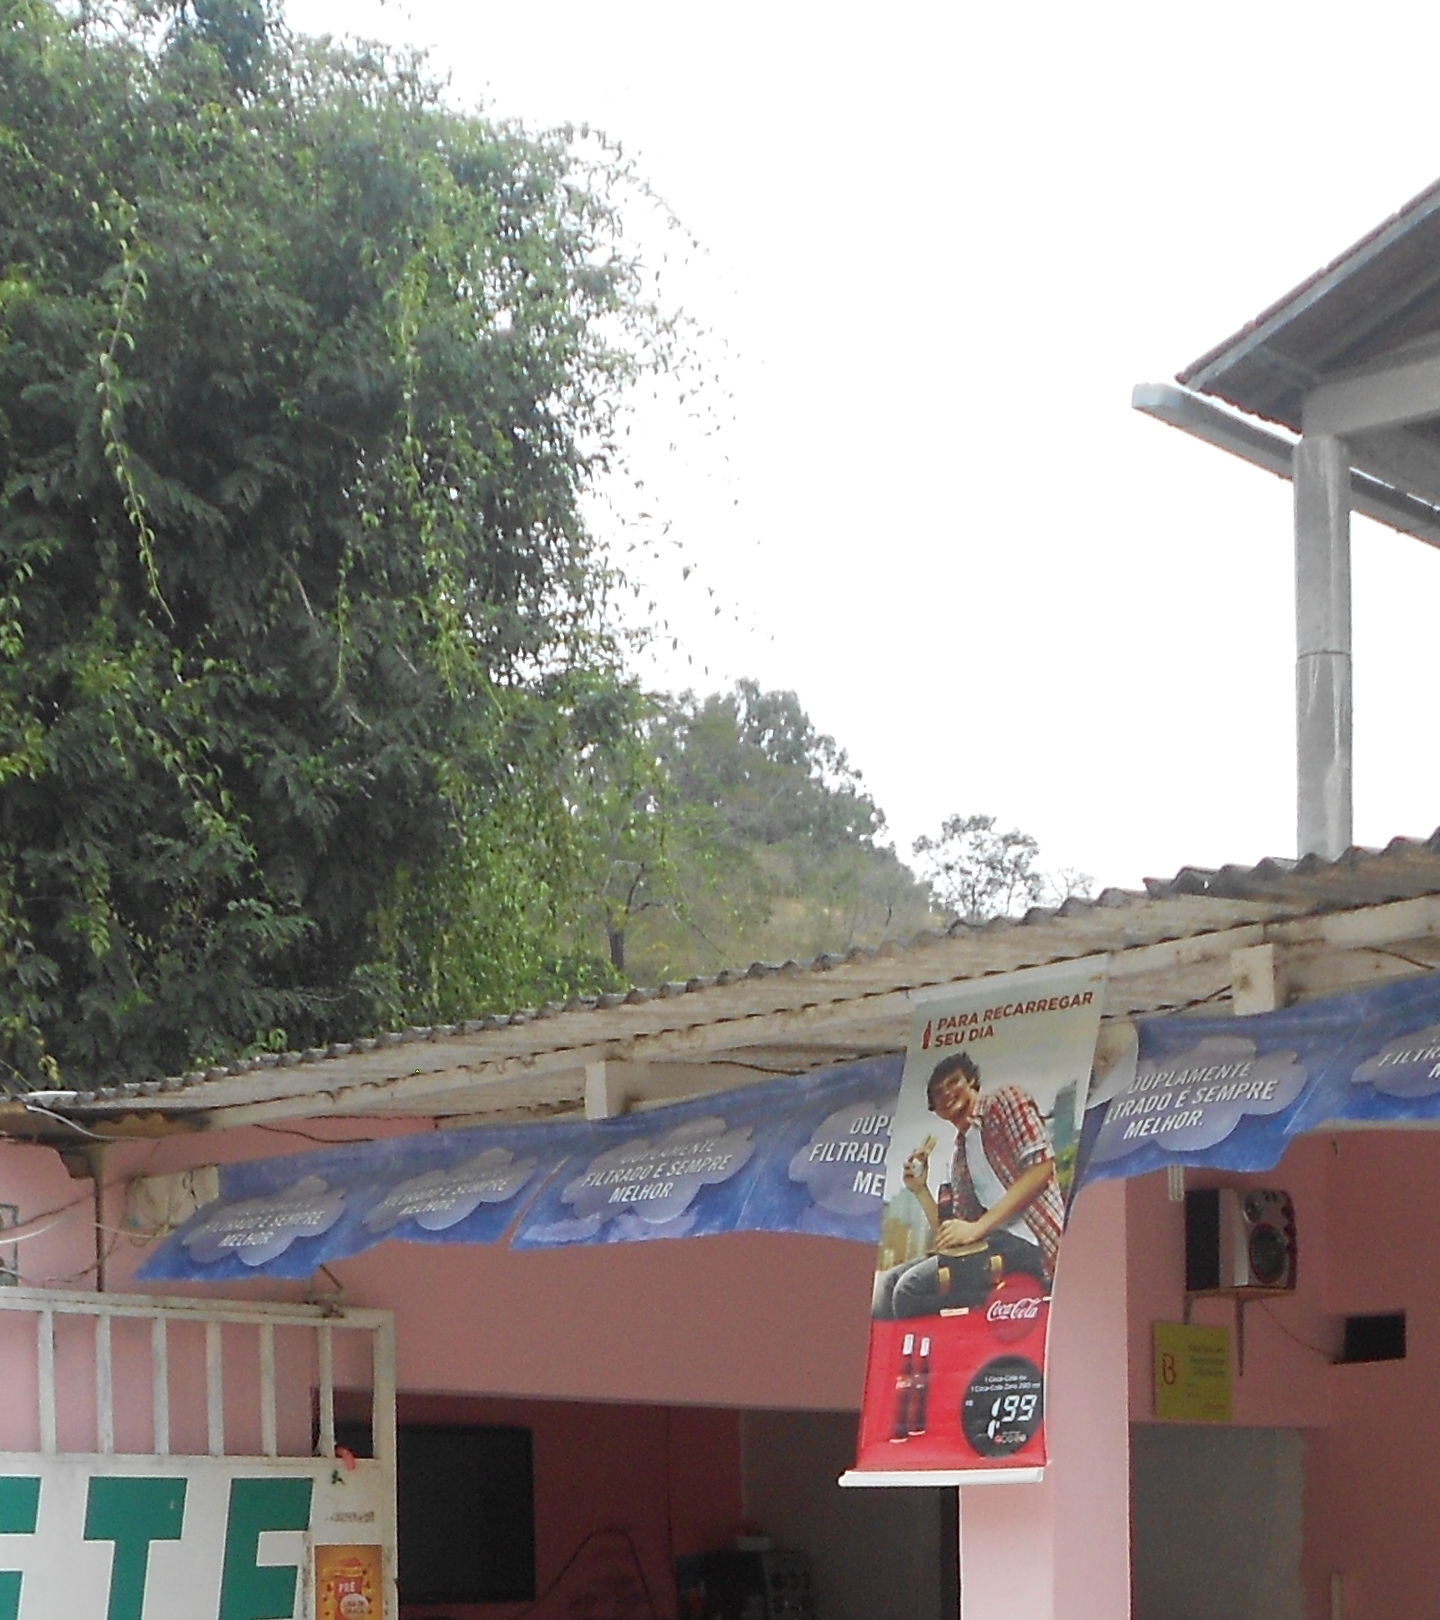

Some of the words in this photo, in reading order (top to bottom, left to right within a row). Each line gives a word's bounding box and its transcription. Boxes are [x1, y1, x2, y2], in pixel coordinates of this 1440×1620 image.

[936, 1011, 979, 1031] PARA
[983, 991, 1094, 1022] RECARREGAR
[934, 1031, 965, 1048] SEU
[968, 1024, 995, 1042] DIA
[1128, 1062, 1256, 1094] DUPLAMENTE
[1192, 1080, 1278, 1105] SEMPRE
[1122, 1110, 1204, 1140] MELHOR.
[581, 1164, 654, 1187] FILTRADO
[666, 1154, 732, 1177] SEMPRE
